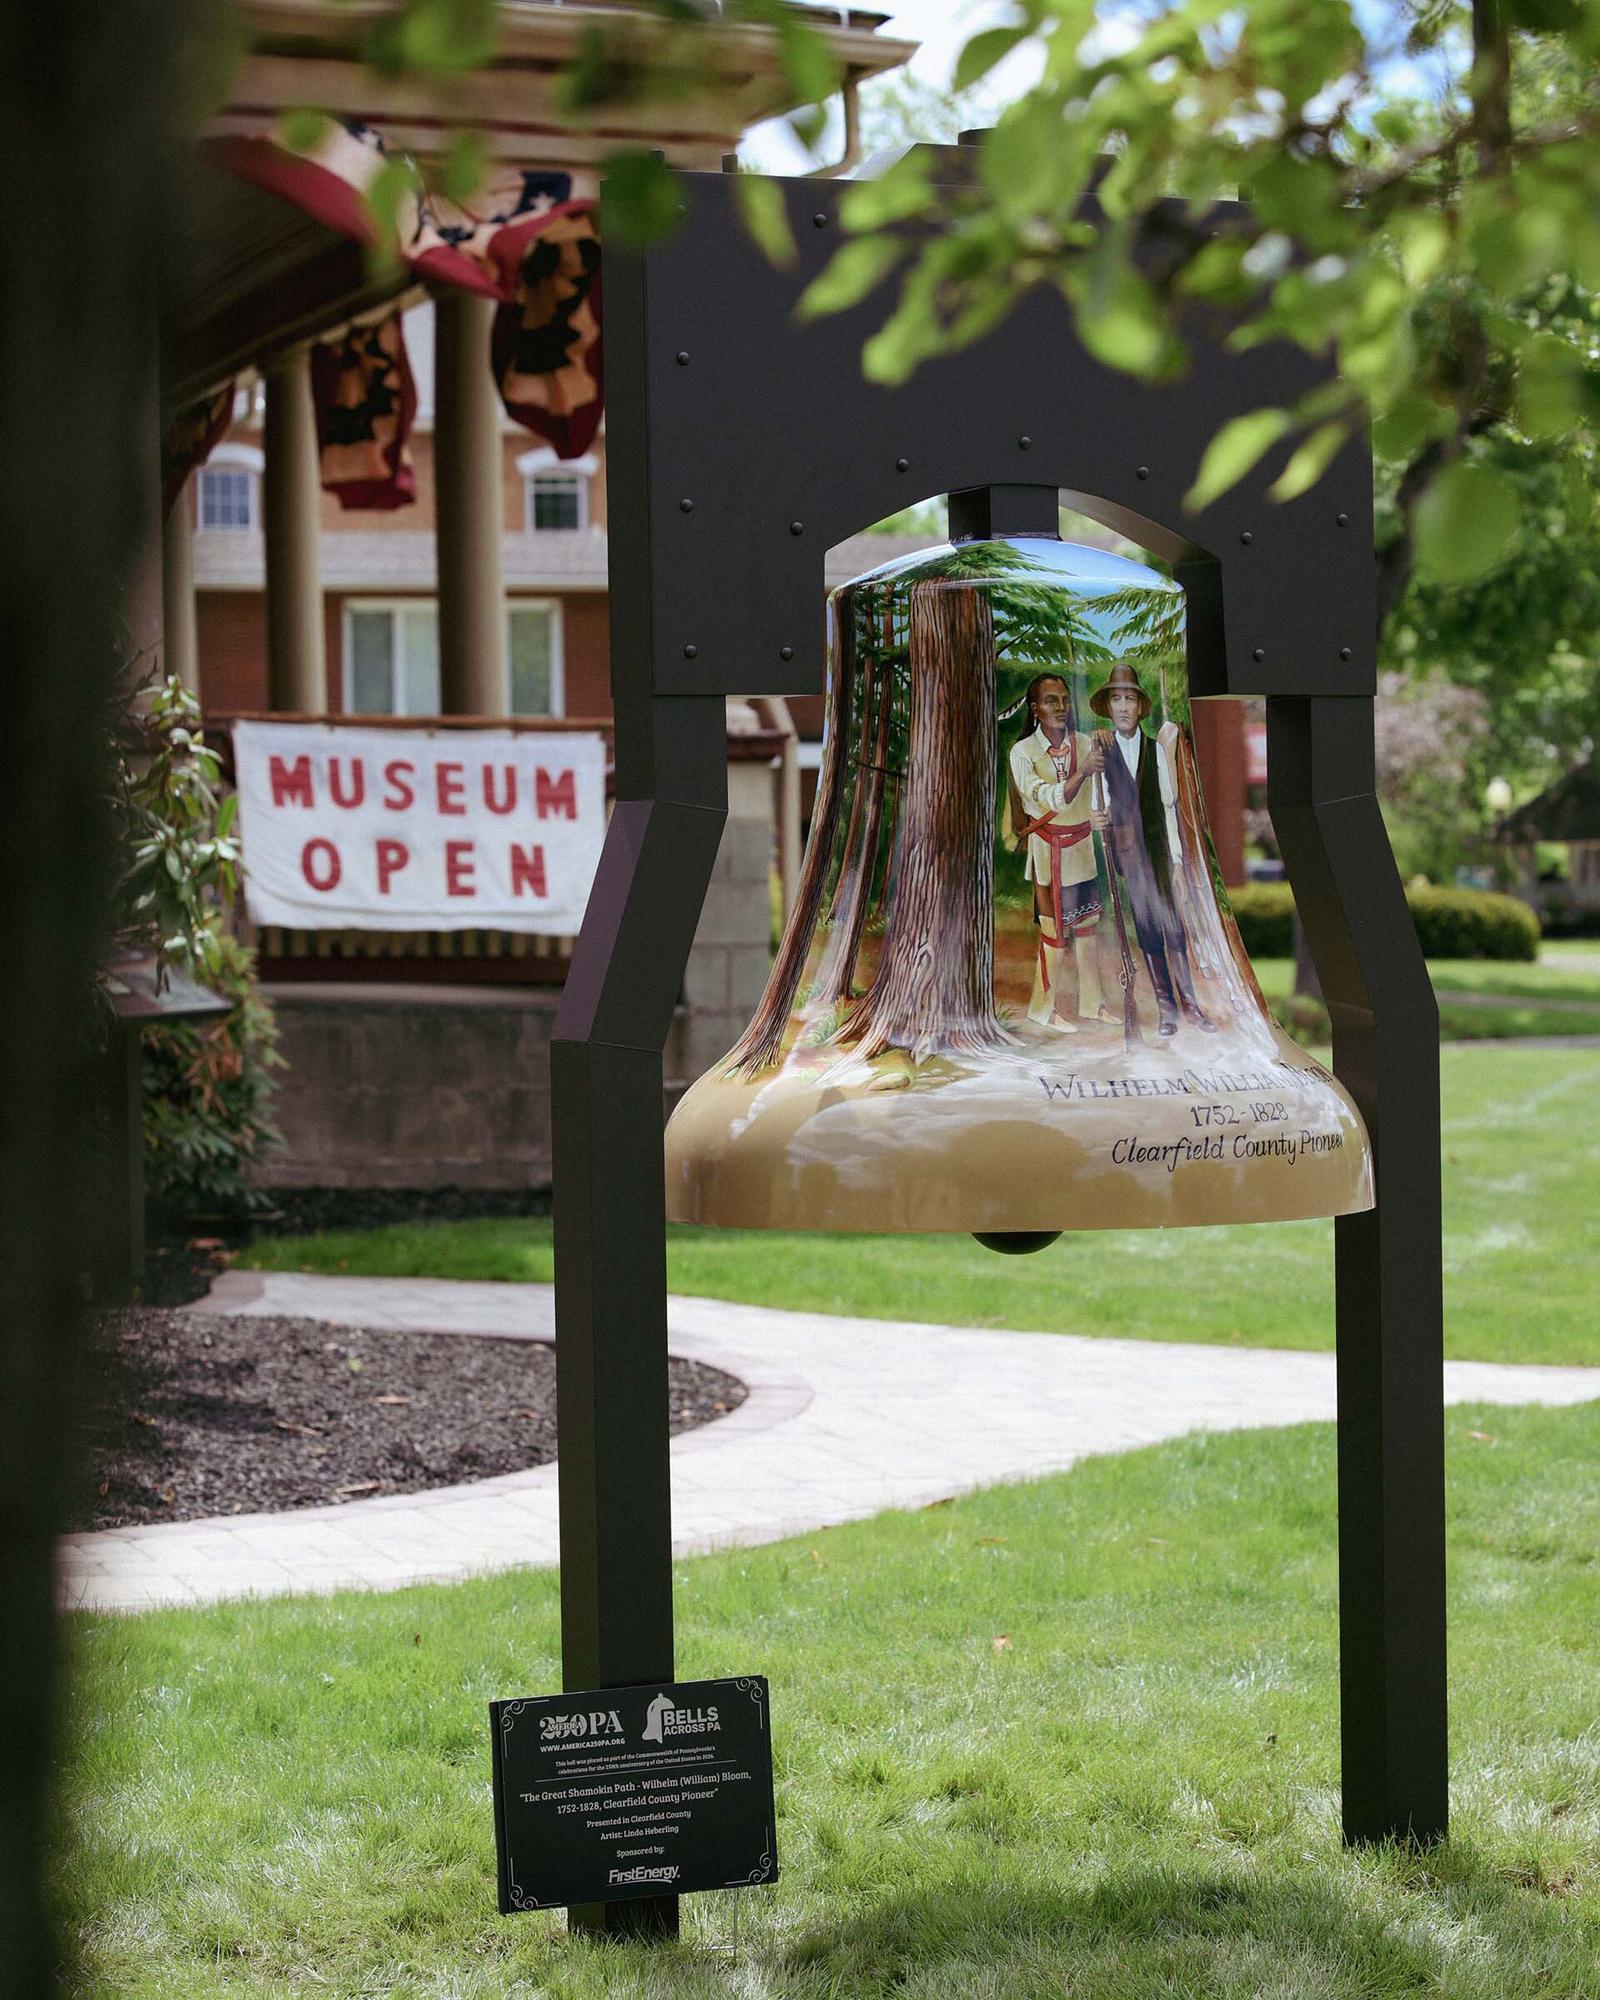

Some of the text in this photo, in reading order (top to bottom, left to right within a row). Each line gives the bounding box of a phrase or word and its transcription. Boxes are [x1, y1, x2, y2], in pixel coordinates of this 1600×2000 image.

[269, 755, 577, 821] MUSEUM
[301, 837, 548, 898] OPEN
[1038, 1073, 1192, 1100] WILHELM
[1190, 1102, 1289, 1127] 1752-1828
[1112, 1134, 1225, 1172] Clearfield
[1233, 1131, 1296, 1166] County
[663, 1706, 719, 1726] BELLS
[663, 1721, 721, 1736] ACROSS PA
[540, 1738, 626, 1753] WWW.AMERICA250PA.ORG
[541, 1791, 567, 1801] Great
[568, 1785, 613, 1798] Shamokin
[614, 1781, 635, 1793] Path
[642, 1778, 679, 1790] Wilhelm
[680, 1773, 720, 1787] (William)
[721, 1771, 752, 1781] Bloom,
[557, 1801, 602, 1814] 1752-1828,
[603, 1796, 647, 1810] Clearfield
[648, 1793, 680, 1804] County
[586, 1810, 692, 1828] Presented in Clearfield County
[600, 1824, 680, 1840] Artist: Linda Heberling
[616, 1845, 665, 1859] Sponsored by:
